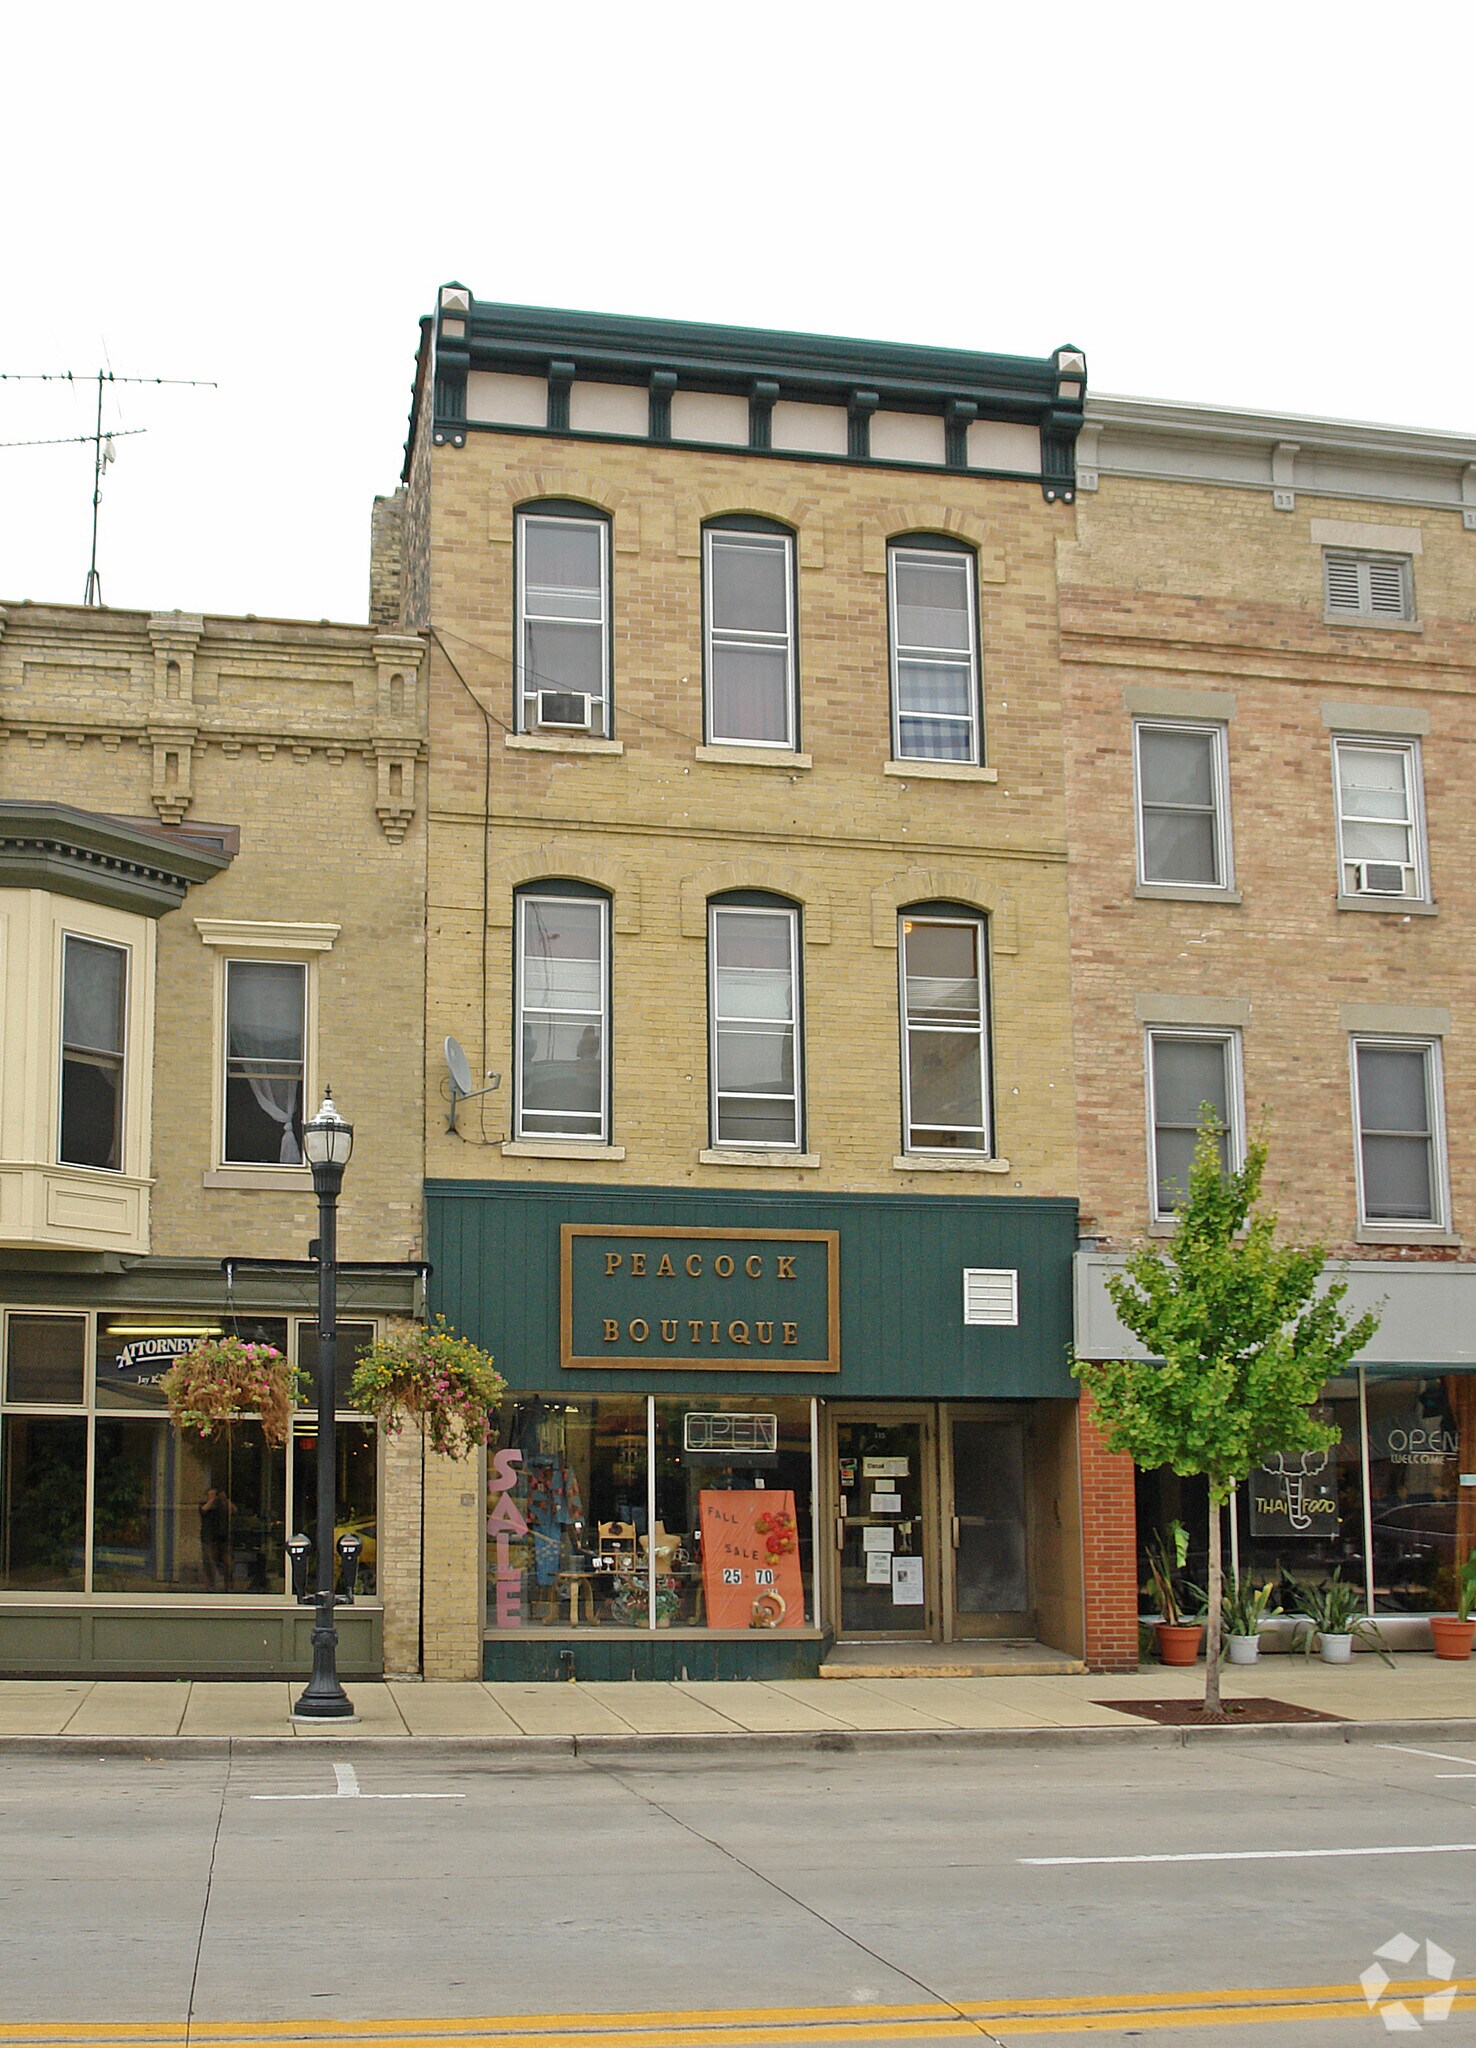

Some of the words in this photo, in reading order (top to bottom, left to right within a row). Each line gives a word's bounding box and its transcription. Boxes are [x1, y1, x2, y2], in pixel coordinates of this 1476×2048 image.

[604, 1252, 798, 1279] PEACOCK
[603, 1318, 798, 1345] BOUTIQUE
[688, 1415, 775, 1450] OPEN
[1388, 1429, 1460, 1452] OPEN
[1390, 1454, 1446, 1465] WELCOME
[707, 1506, 739, 1524] FALL
[1255, 1497, 1288, 1515] THAI
[1302, 1498, 1336, 1514] FOOD
[487, 1448, 529, 1629] SALE
[725, 1544, 759, 1560] SALE
[724, 1569, 741, 1584] 25
[756, 1569, 773, 1584] 70
